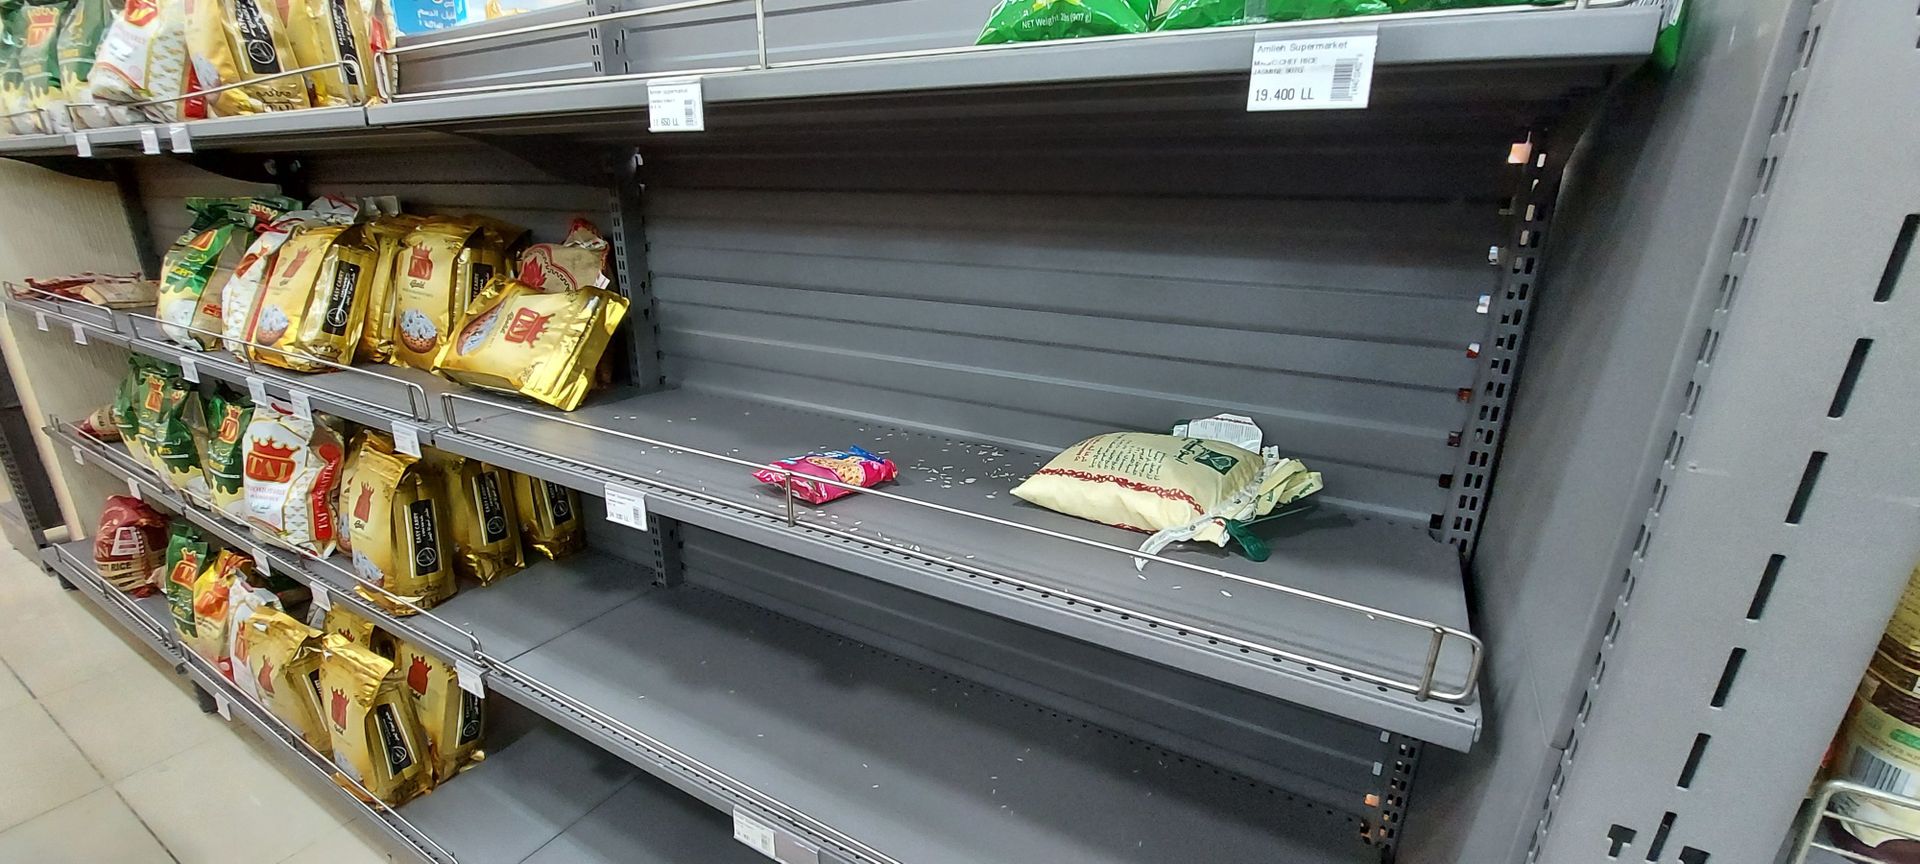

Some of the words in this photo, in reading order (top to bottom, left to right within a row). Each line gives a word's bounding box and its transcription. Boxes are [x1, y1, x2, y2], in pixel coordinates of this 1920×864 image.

[1022, 19, 1035, 29] NET
[1035, 14, 1059, 27] Weight
[1257, 44, 1286, 53] Amlieh
[1289, 41, 1348, 52] Supermarket
[1255, 87, 1295, 101] 19.400
[1301, 87, 1315, 100] LL
[333, 287, 341, 301] EASY
[508, 311, 538, 341] TAJ
[249, 455, 288, 480] TAJ
[111, 562, 132, 571] RICE
